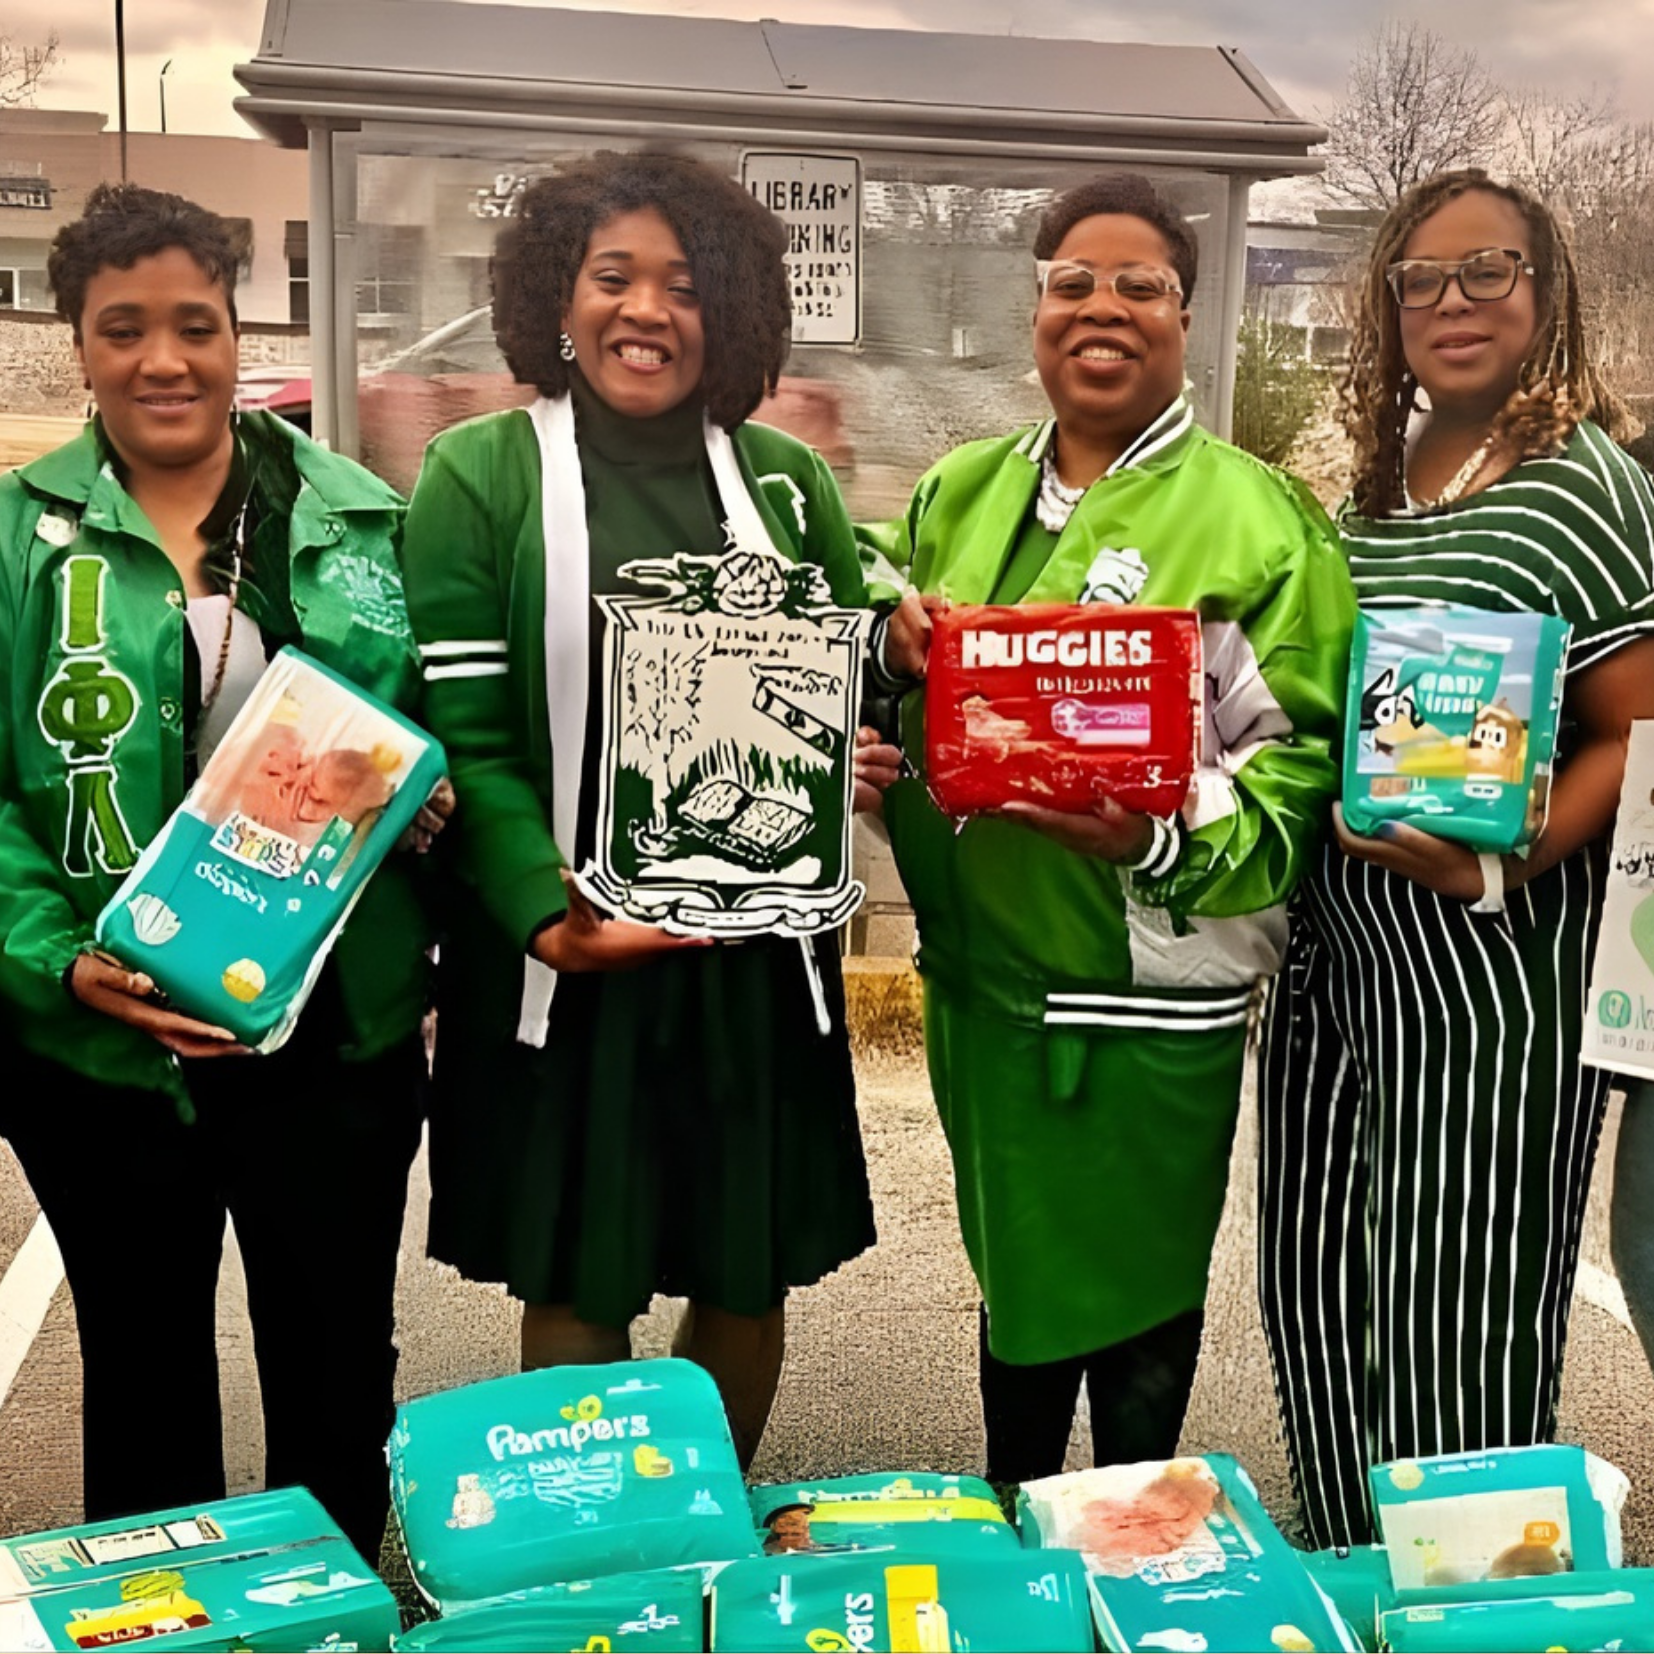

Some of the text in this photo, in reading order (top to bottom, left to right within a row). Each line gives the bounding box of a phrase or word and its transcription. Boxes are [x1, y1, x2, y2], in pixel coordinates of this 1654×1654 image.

[790, 224, 851, 254] KING
[961, 629, 1152, 669] HUGGIES
[486, 1414, 651, 1462] Pampers
